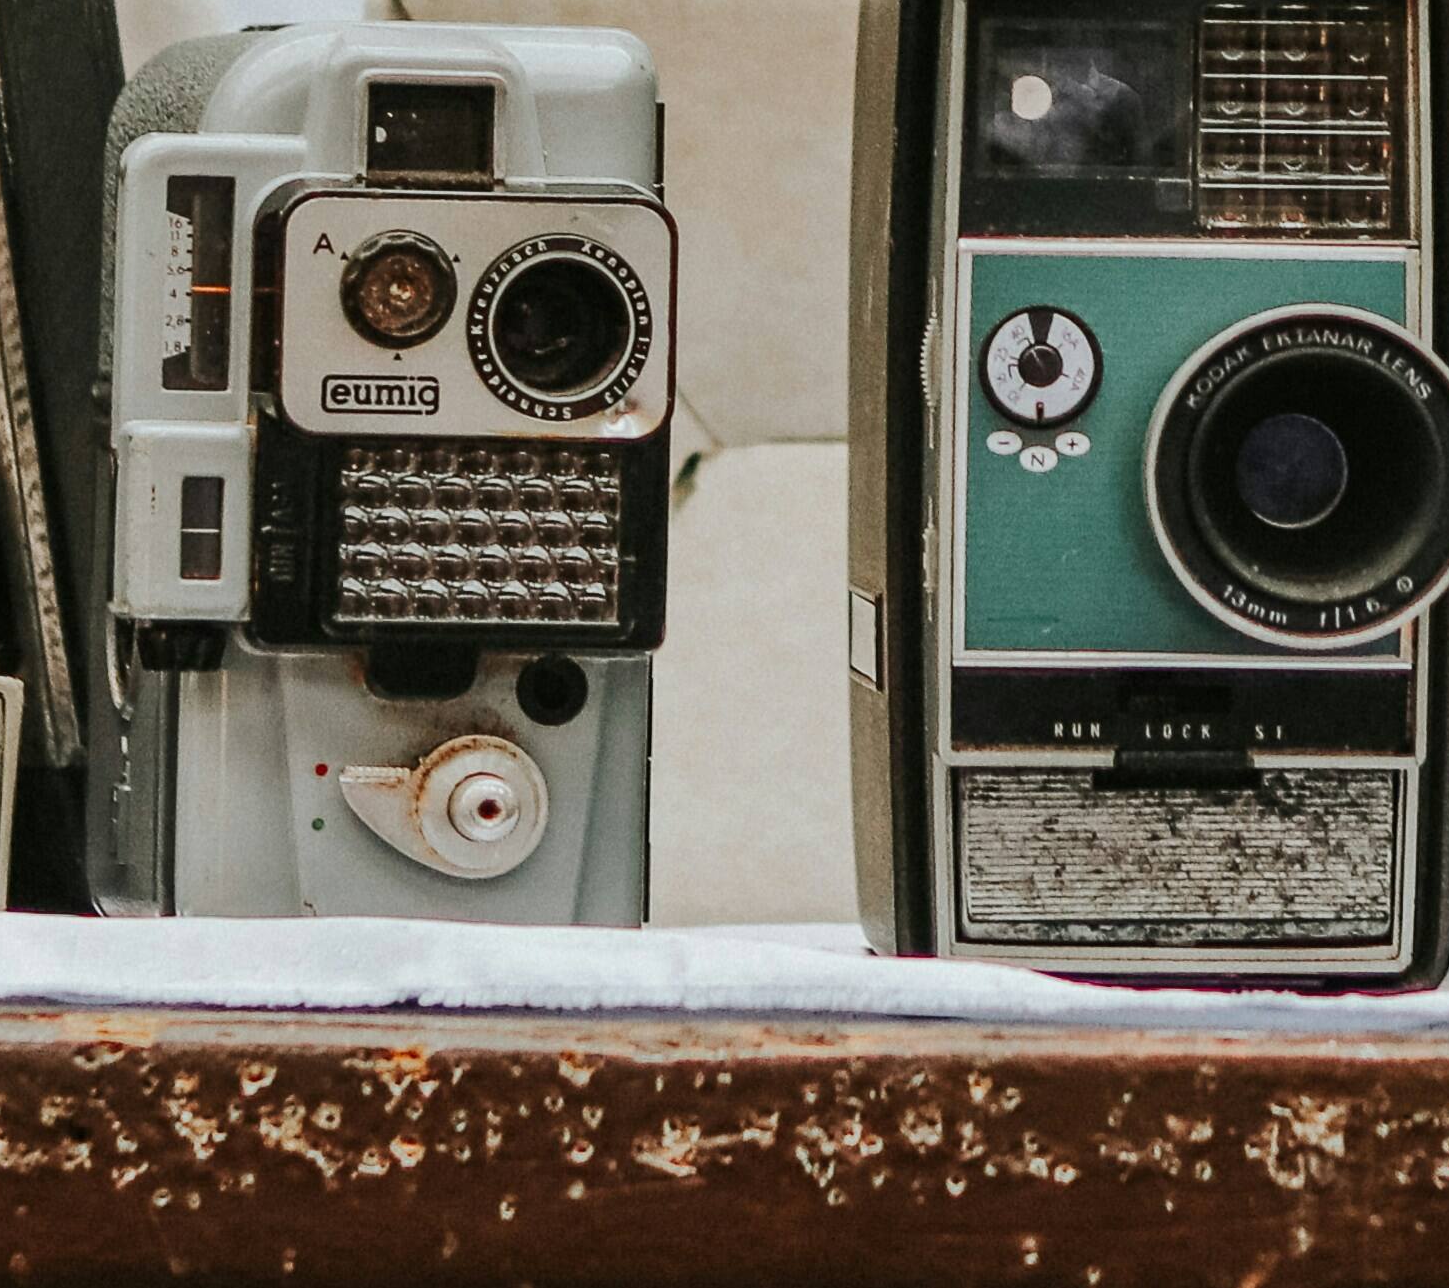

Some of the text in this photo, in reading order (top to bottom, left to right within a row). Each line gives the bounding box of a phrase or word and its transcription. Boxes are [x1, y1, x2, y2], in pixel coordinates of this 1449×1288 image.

[171, 245, 179, 257] 8
[312, 232, 335, 255] A
[170, 288, 178, 299] 4
[580, 237, 651, 325] Xenoplan
[1185, 327, 1433, 410] KODAK EKTANAR LENS
[328, 376, 441, 415] eumig
[1222, 583, 1288, 626] 13mm
[1054, 722, 1101, 739] RUN
[1145, 723, 1211, 741] LOCK
